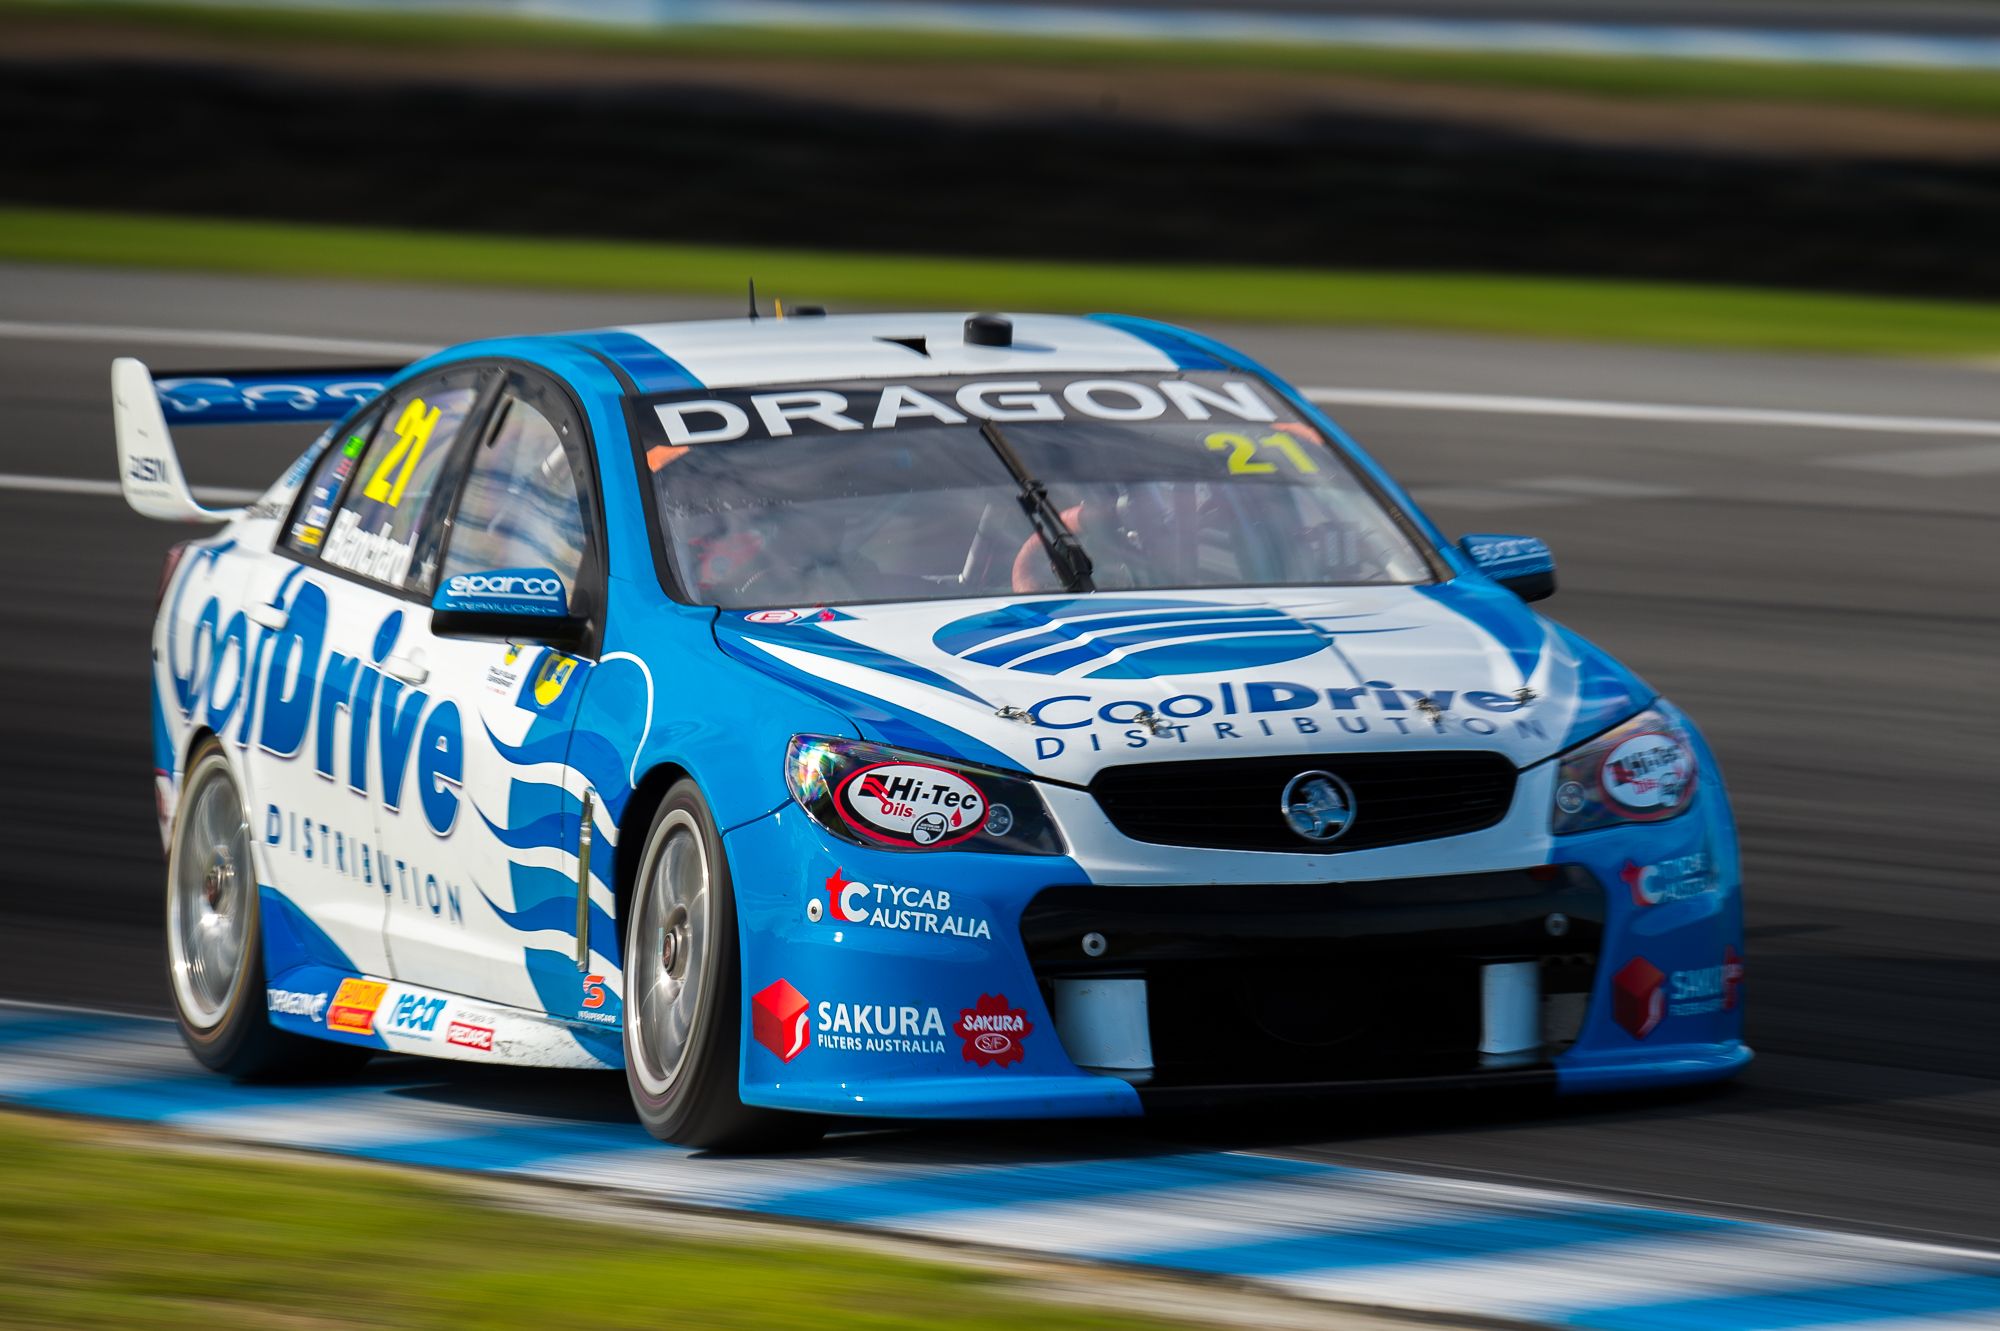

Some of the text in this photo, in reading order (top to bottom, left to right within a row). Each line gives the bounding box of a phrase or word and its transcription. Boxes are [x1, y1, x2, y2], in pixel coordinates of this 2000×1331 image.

[653, 379, 1278, 446] DRAGON
[363, 397, 442, 508] 21
[1204, 431, 1318, 476] 21
[450, 575, 561, 597] sparco
[1030, 679, 1525, 730] CoolDrive
[1036, 714, 1549, 761] DISTRIBUTION
[887, 776, 977, 809] Hi-Tec
[881, 802, 913, 818] Oils
[264, 803, 466, 930] DISTRIBUTION
[873, 884, 950, 911] TYCAB
[869, 908, 992, 940] AUSTRALIA
[818, 1001, 946, 1036] SAKURA
[962, 1014, 1024, 1032] SAKURA
[818, 1034, 945, 1053] FILTERS AUSTRALIA
